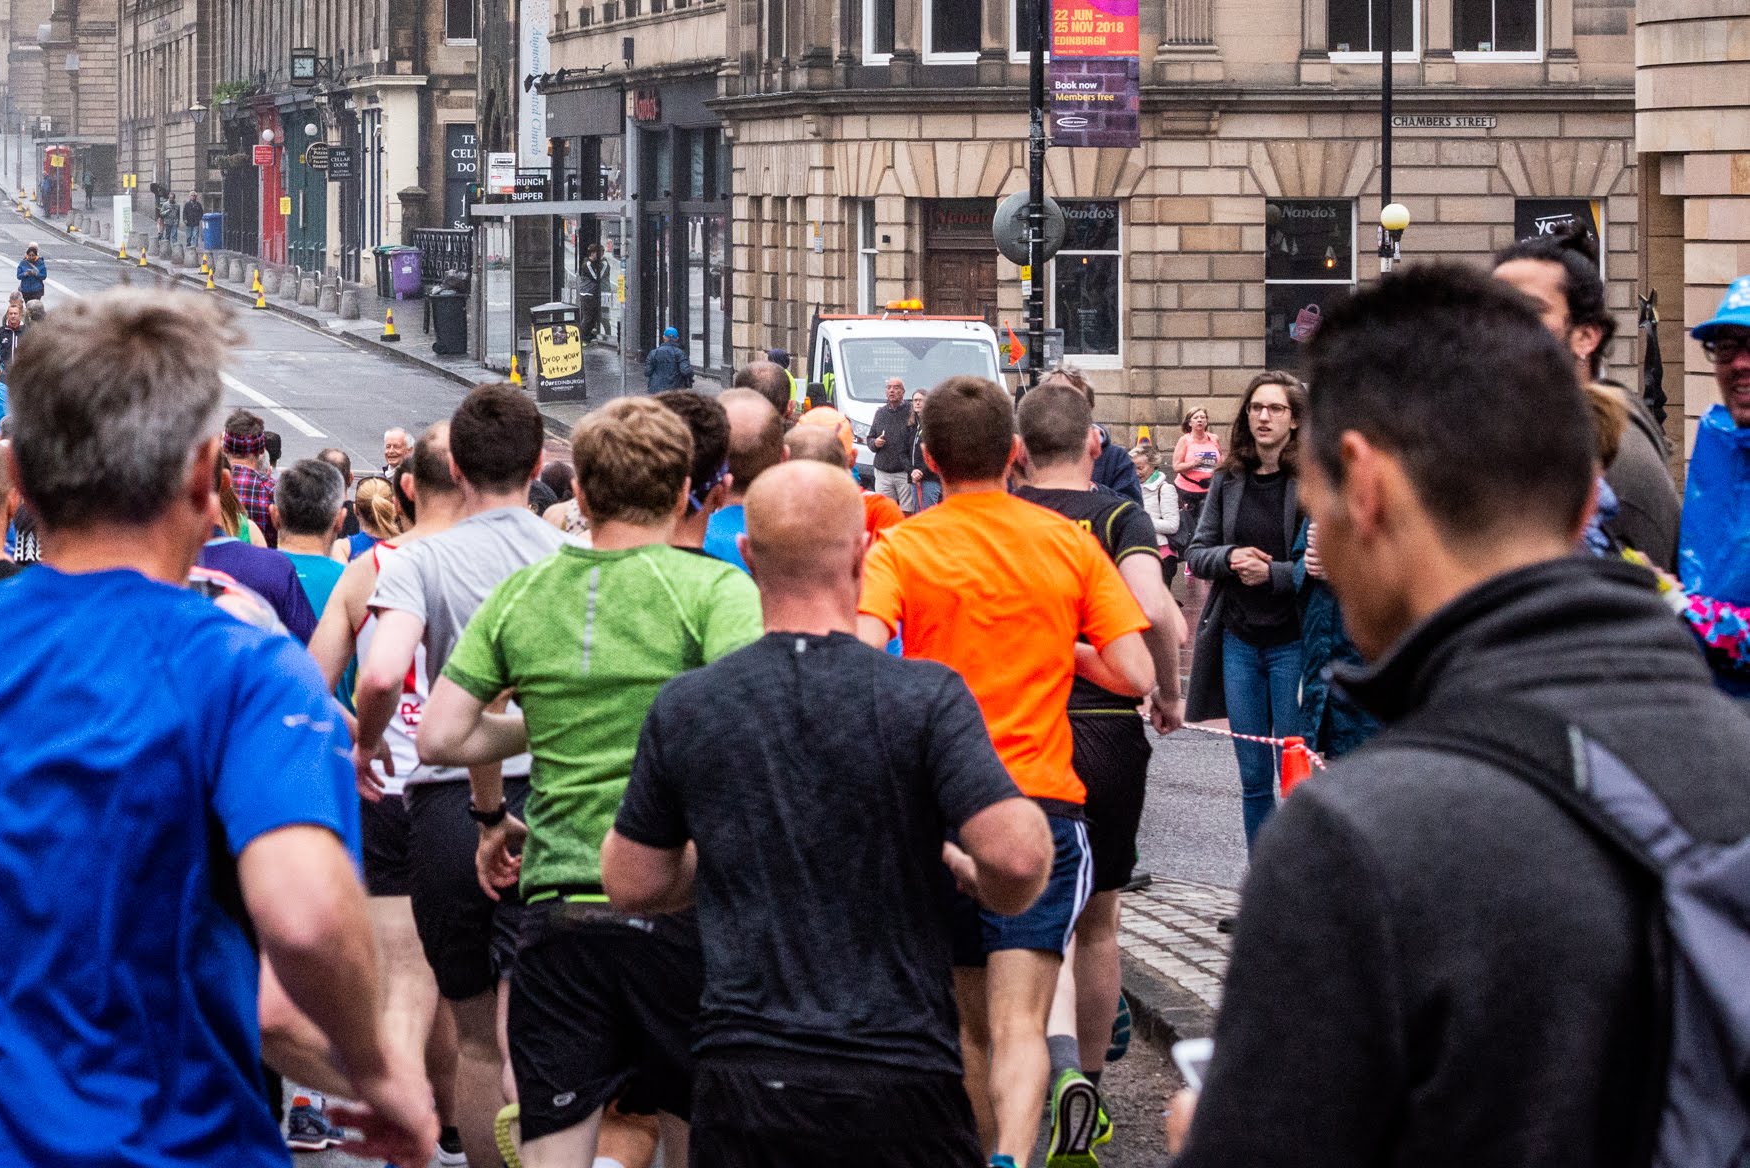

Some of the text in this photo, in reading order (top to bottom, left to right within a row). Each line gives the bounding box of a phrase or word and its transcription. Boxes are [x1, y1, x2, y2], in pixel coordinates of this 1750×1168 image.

[1055, 10, 1069, 20] 22
[1071, 10, 1093, 20] JUN
[1055, 22, 1124, 32] 25 NOV 2018
[1055, 36, 1106, 45] EDINBURGH
[1055, 81, 1077, 89] Book
[1393, 117, 1493, 126] CHAMBERS STREET
[462, 135, 476, 144] TH
[531, 118, 542, 156] Church
[458, 163, 476, 172] DO
[1061, 206, 1115, 219] Nando's
[1282, 206, 1336, 218] Nando's
[539, 331, 552, 344] I'm
[542, 352, 579, 365] Drop your
